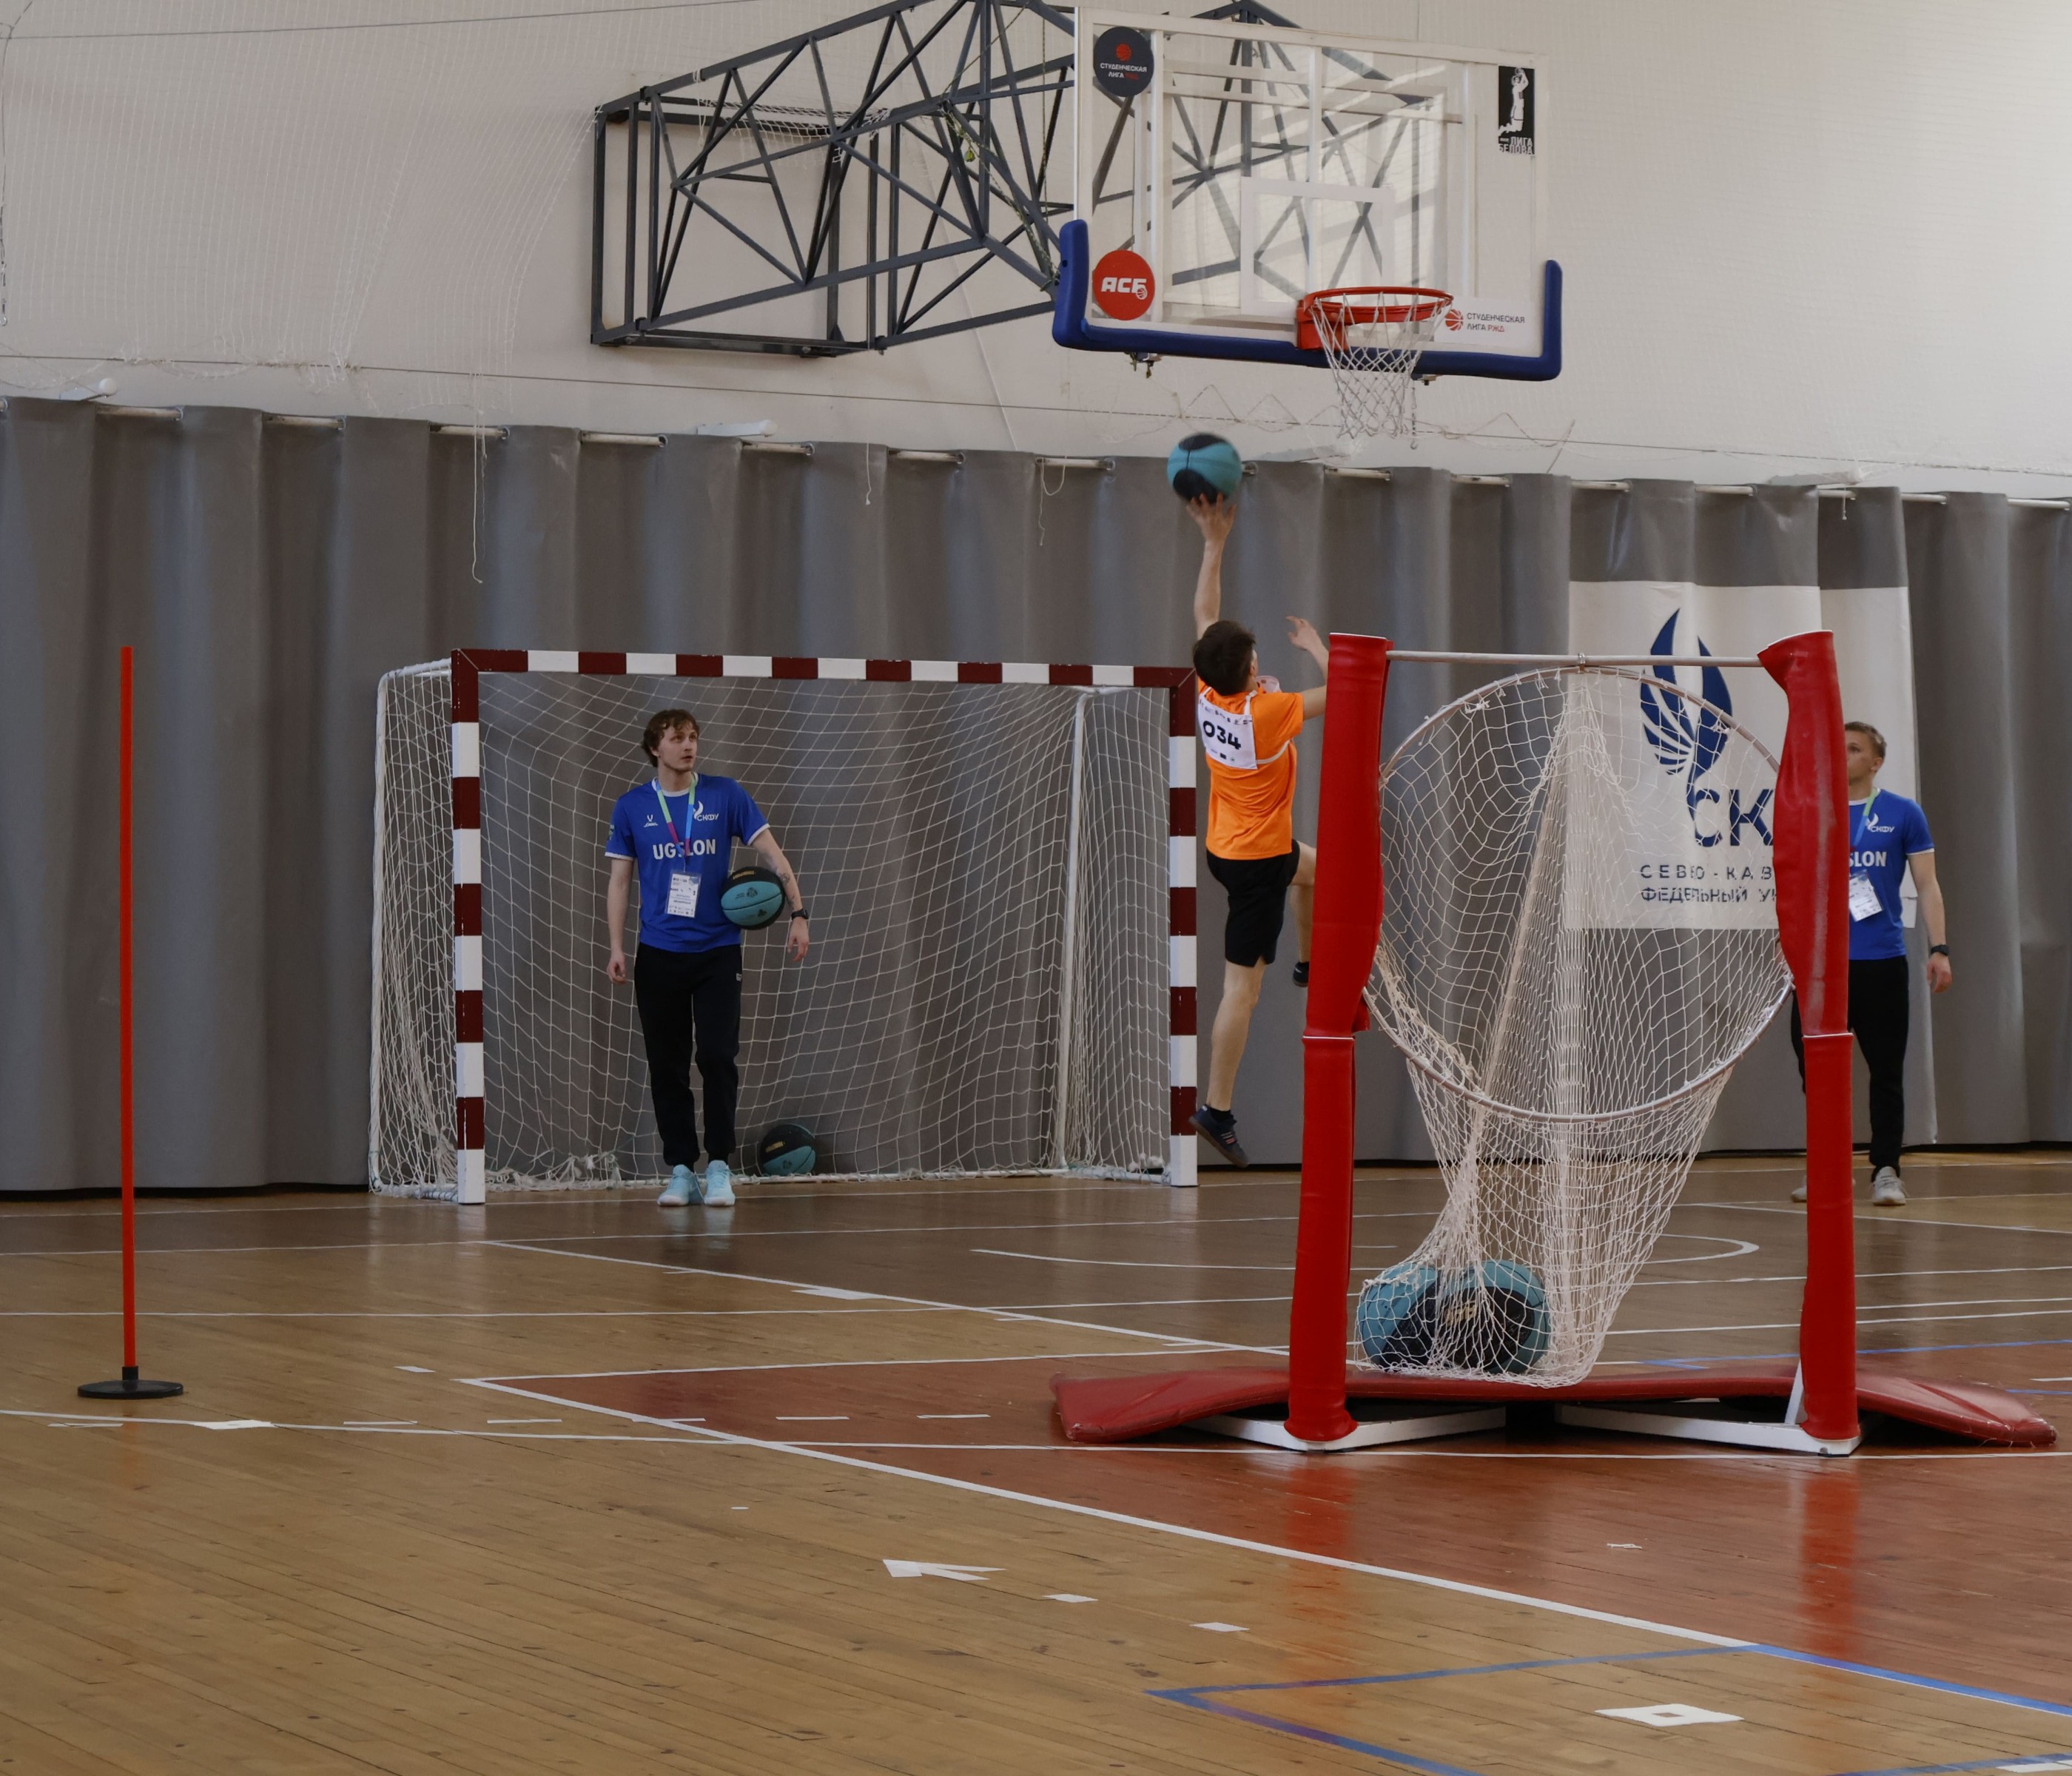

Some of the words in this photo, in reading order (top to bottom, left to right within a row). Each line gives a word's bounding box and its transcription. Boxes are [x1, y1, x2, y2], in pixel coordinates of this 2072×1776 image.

[1100, 62, 1148, 73] СТУДЕНЧЕСКАЯ
[1100, 277, 1148, 300] АСБ
[1466, 312, 1526, 323] СТУДЕНЧЕСКАЯ
[1466, 323, 1487, 332] ЛИГА
[1487, 324, 1505, 332] РЖД
[1202, 720, 1242, 750] 034
[1693, 788, 1774, 848] СК
